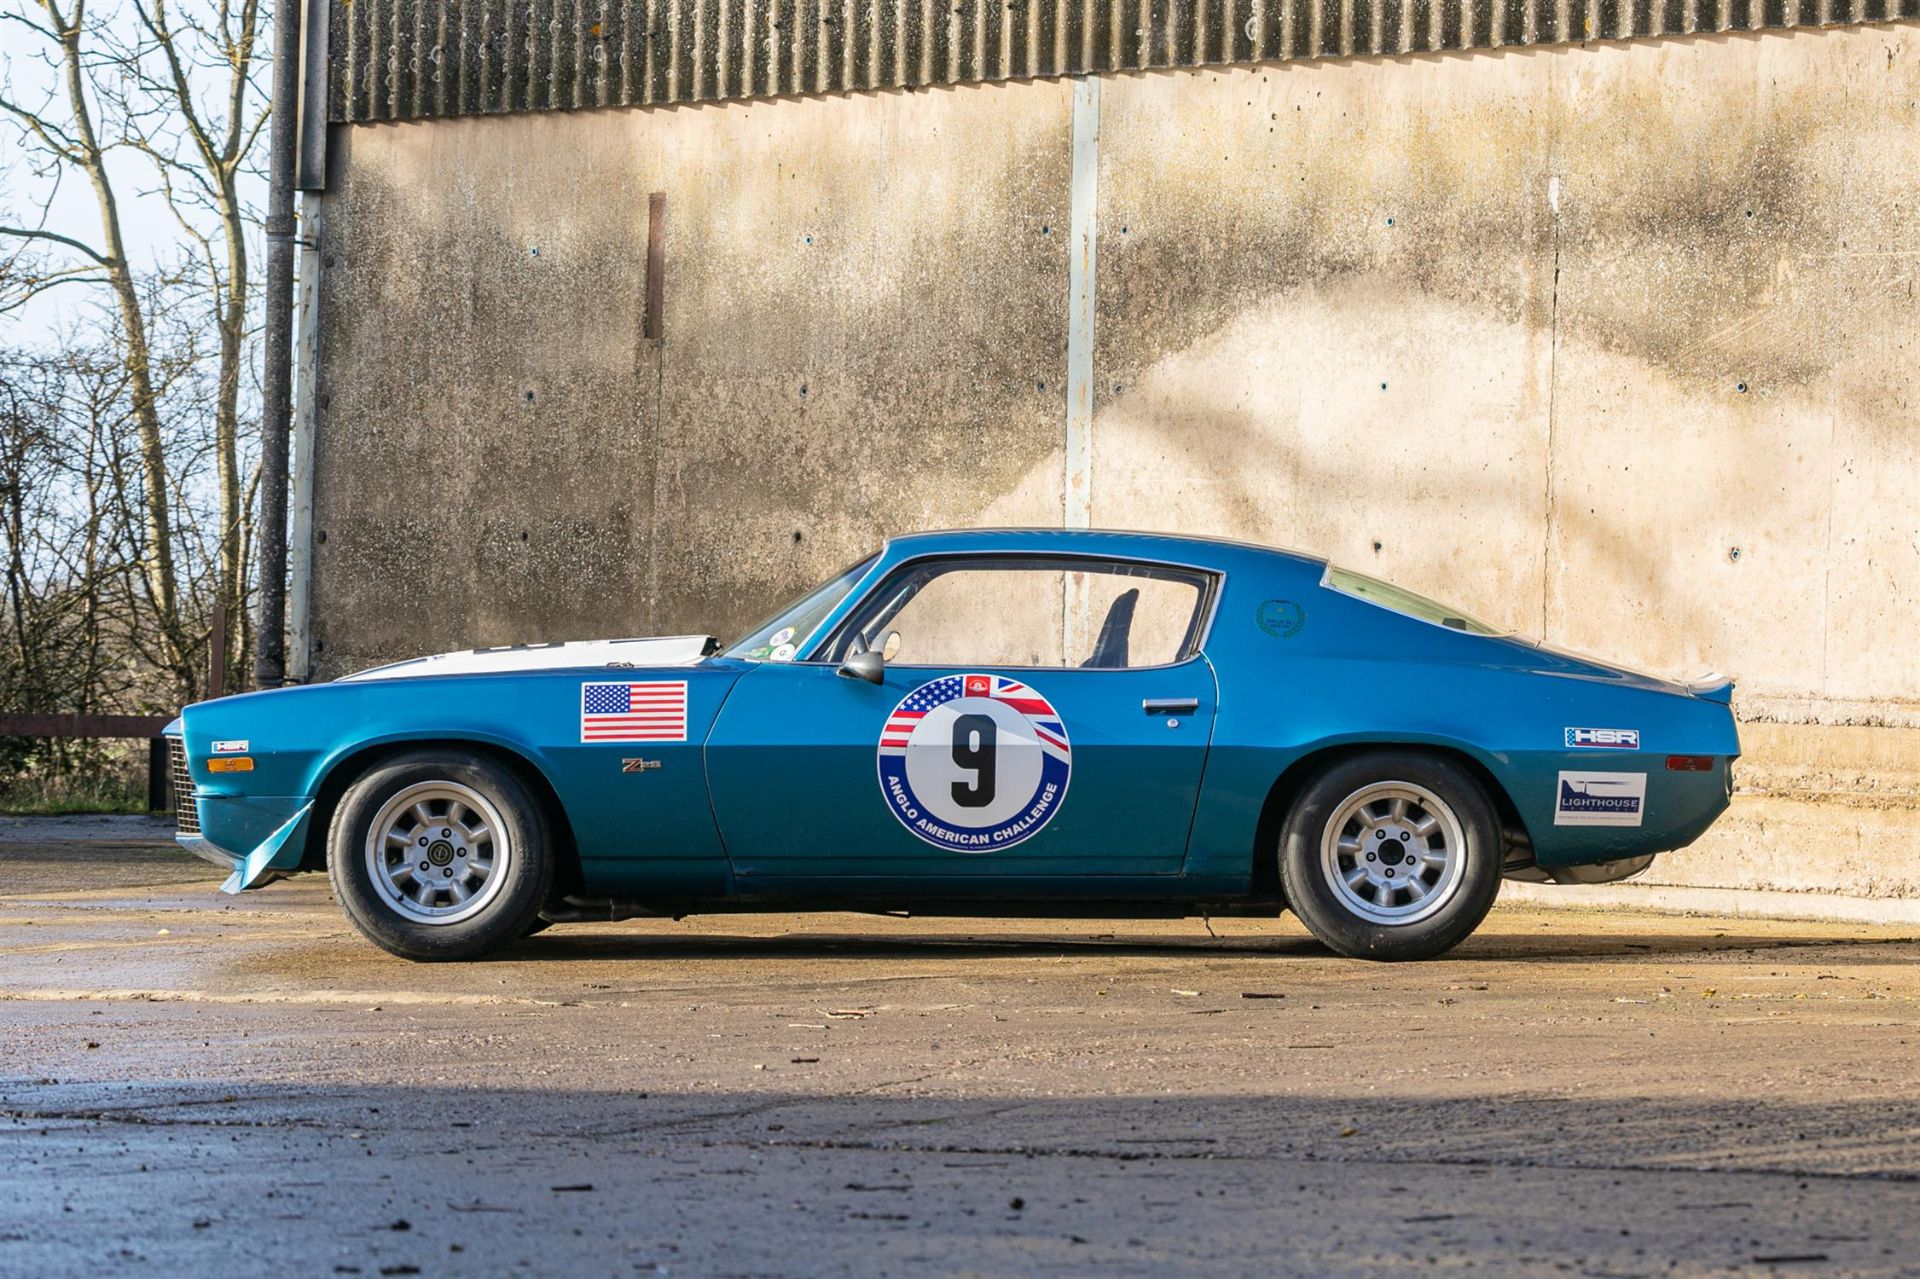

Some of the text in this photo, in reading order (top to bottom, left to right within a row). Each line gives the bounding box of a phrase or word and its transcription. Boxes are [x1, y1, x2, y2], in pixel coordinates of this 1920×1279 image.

[1575, 729, 1637, 744] HSR
[951, 714, 997, 807] 9
[888, 775, 918, 820] ANGLO
[916, 818, 990, 845] AMERICAN
[995, 783, 1058, 842] CHALLENGE
[1562, 798, 1638, 808] LIGHTHOUSE
